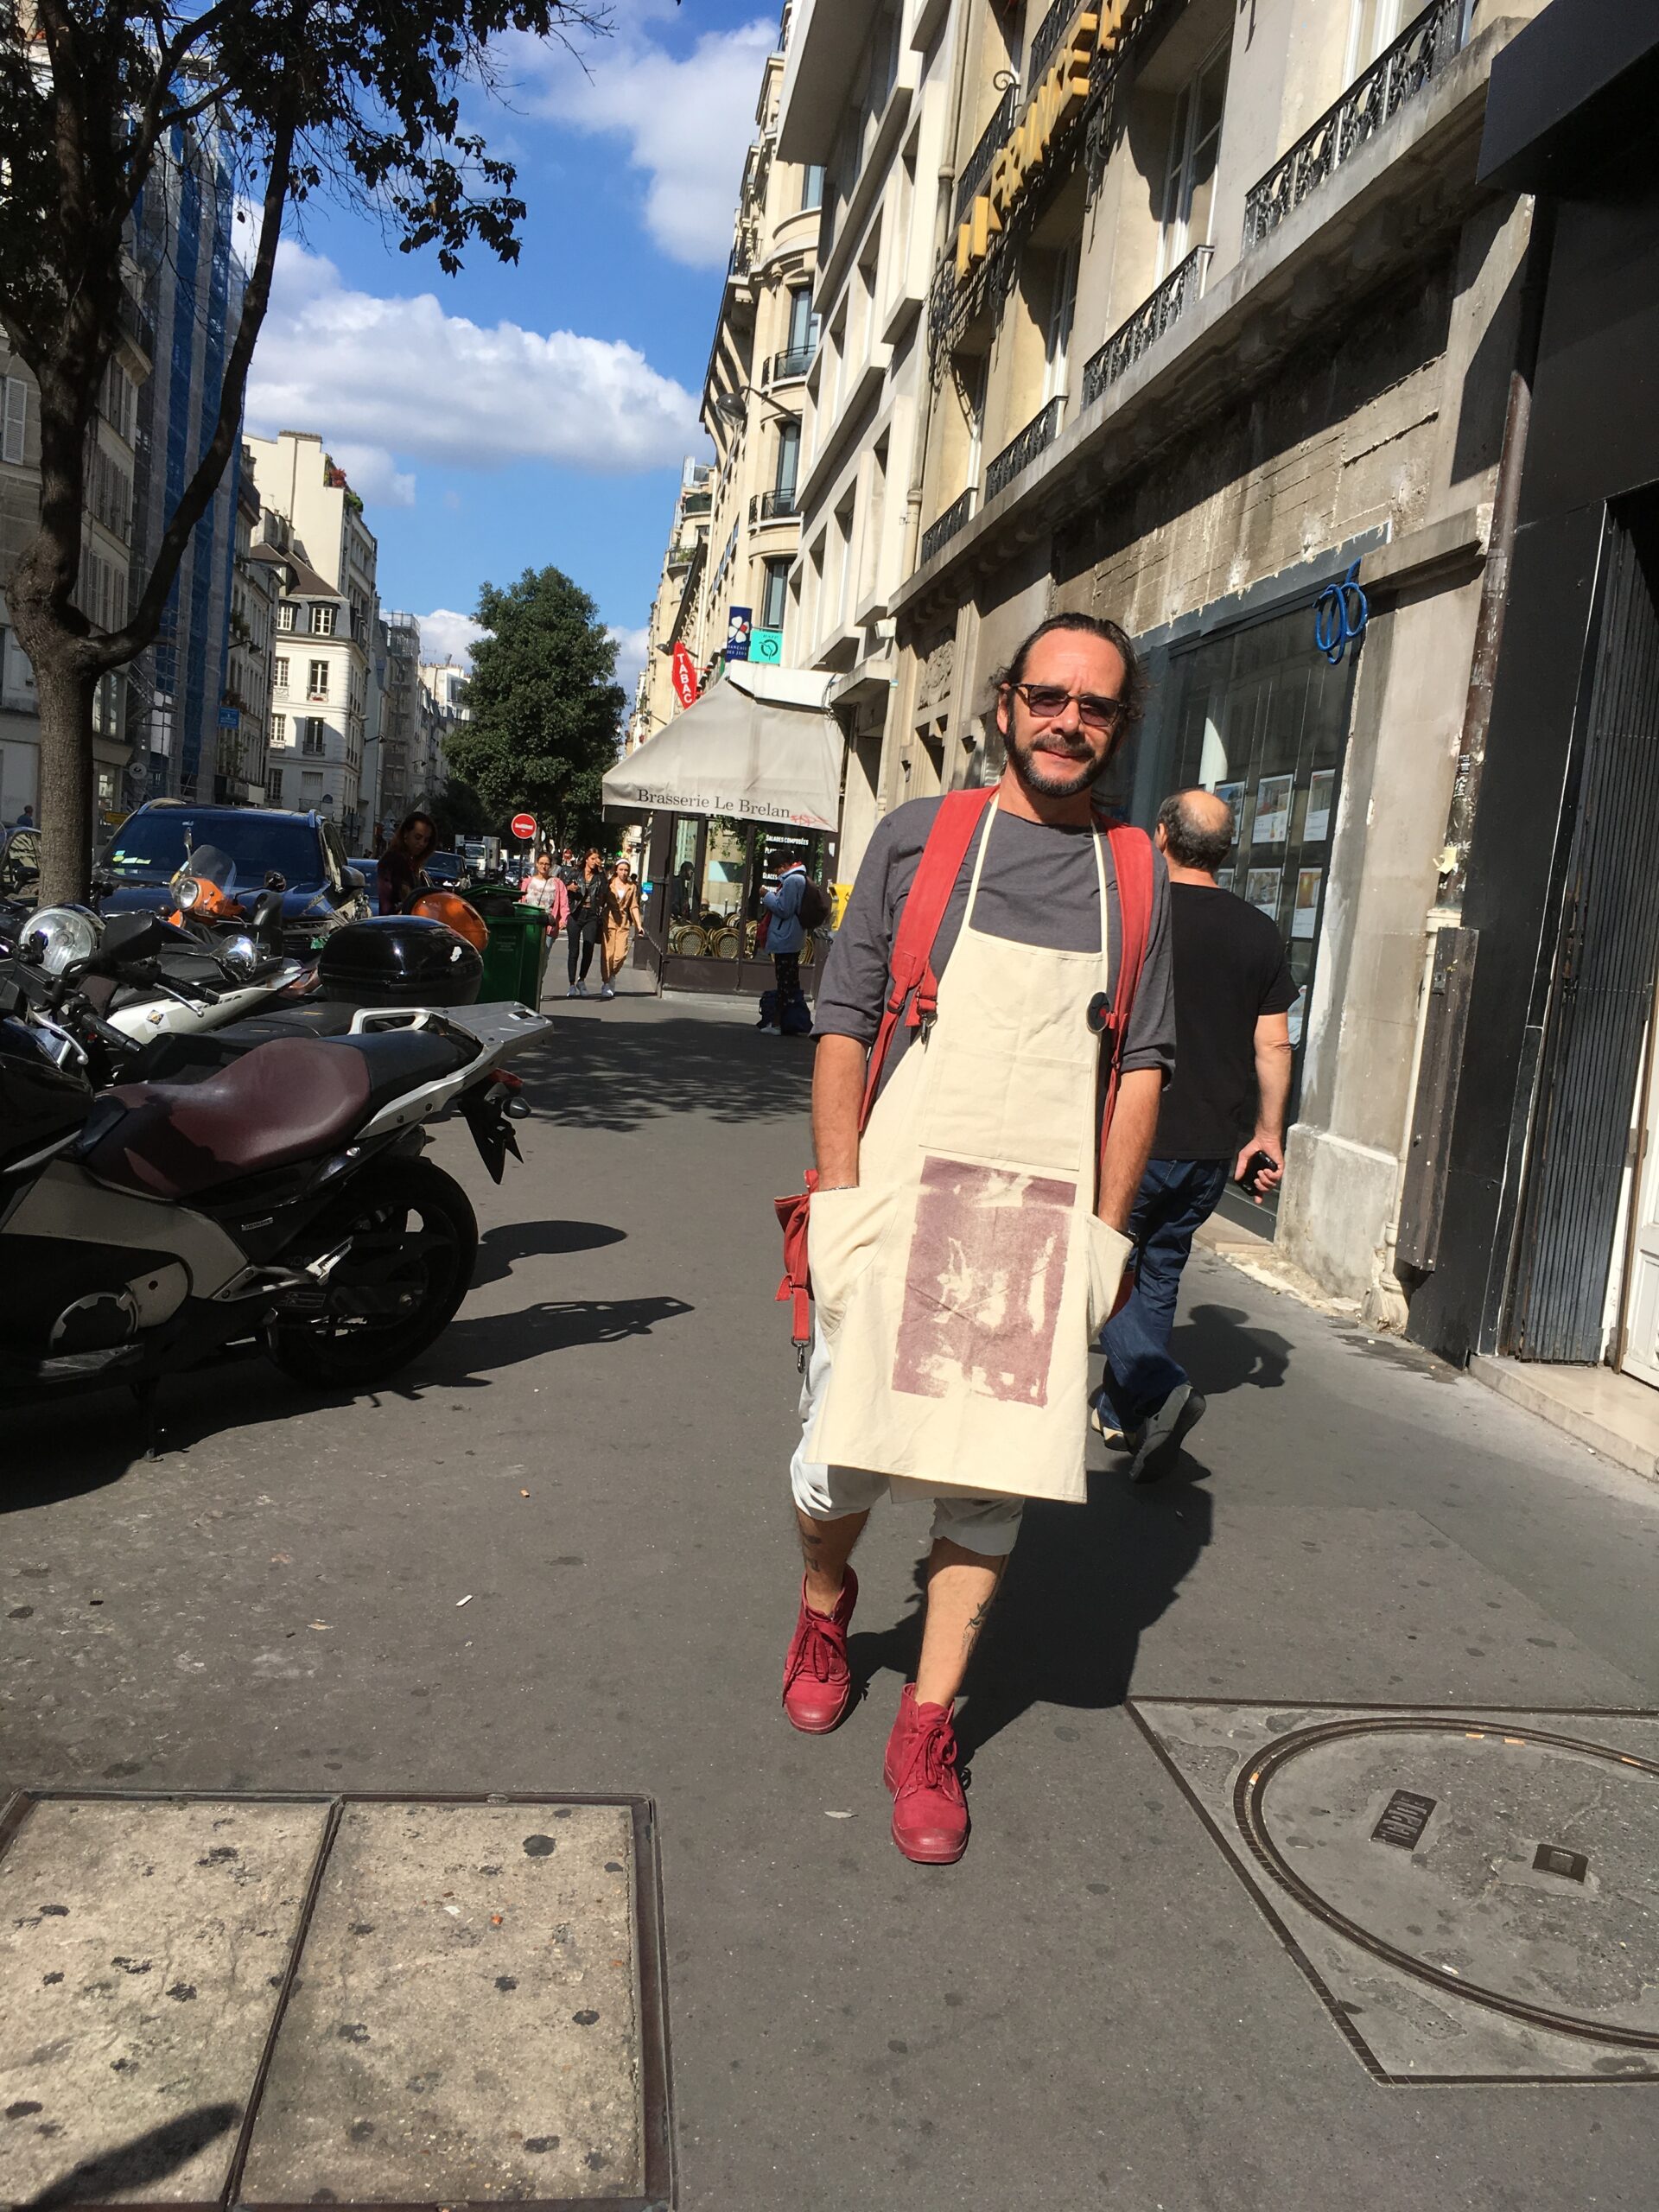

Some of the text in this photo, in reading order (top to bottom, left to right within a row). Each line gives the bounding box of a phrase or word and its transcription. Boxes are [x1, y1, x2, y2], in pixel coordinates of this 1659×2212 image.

[677, 652, 693, 704] TABAC
[637, 789, 791, 819] Brasserie Le Brelan
